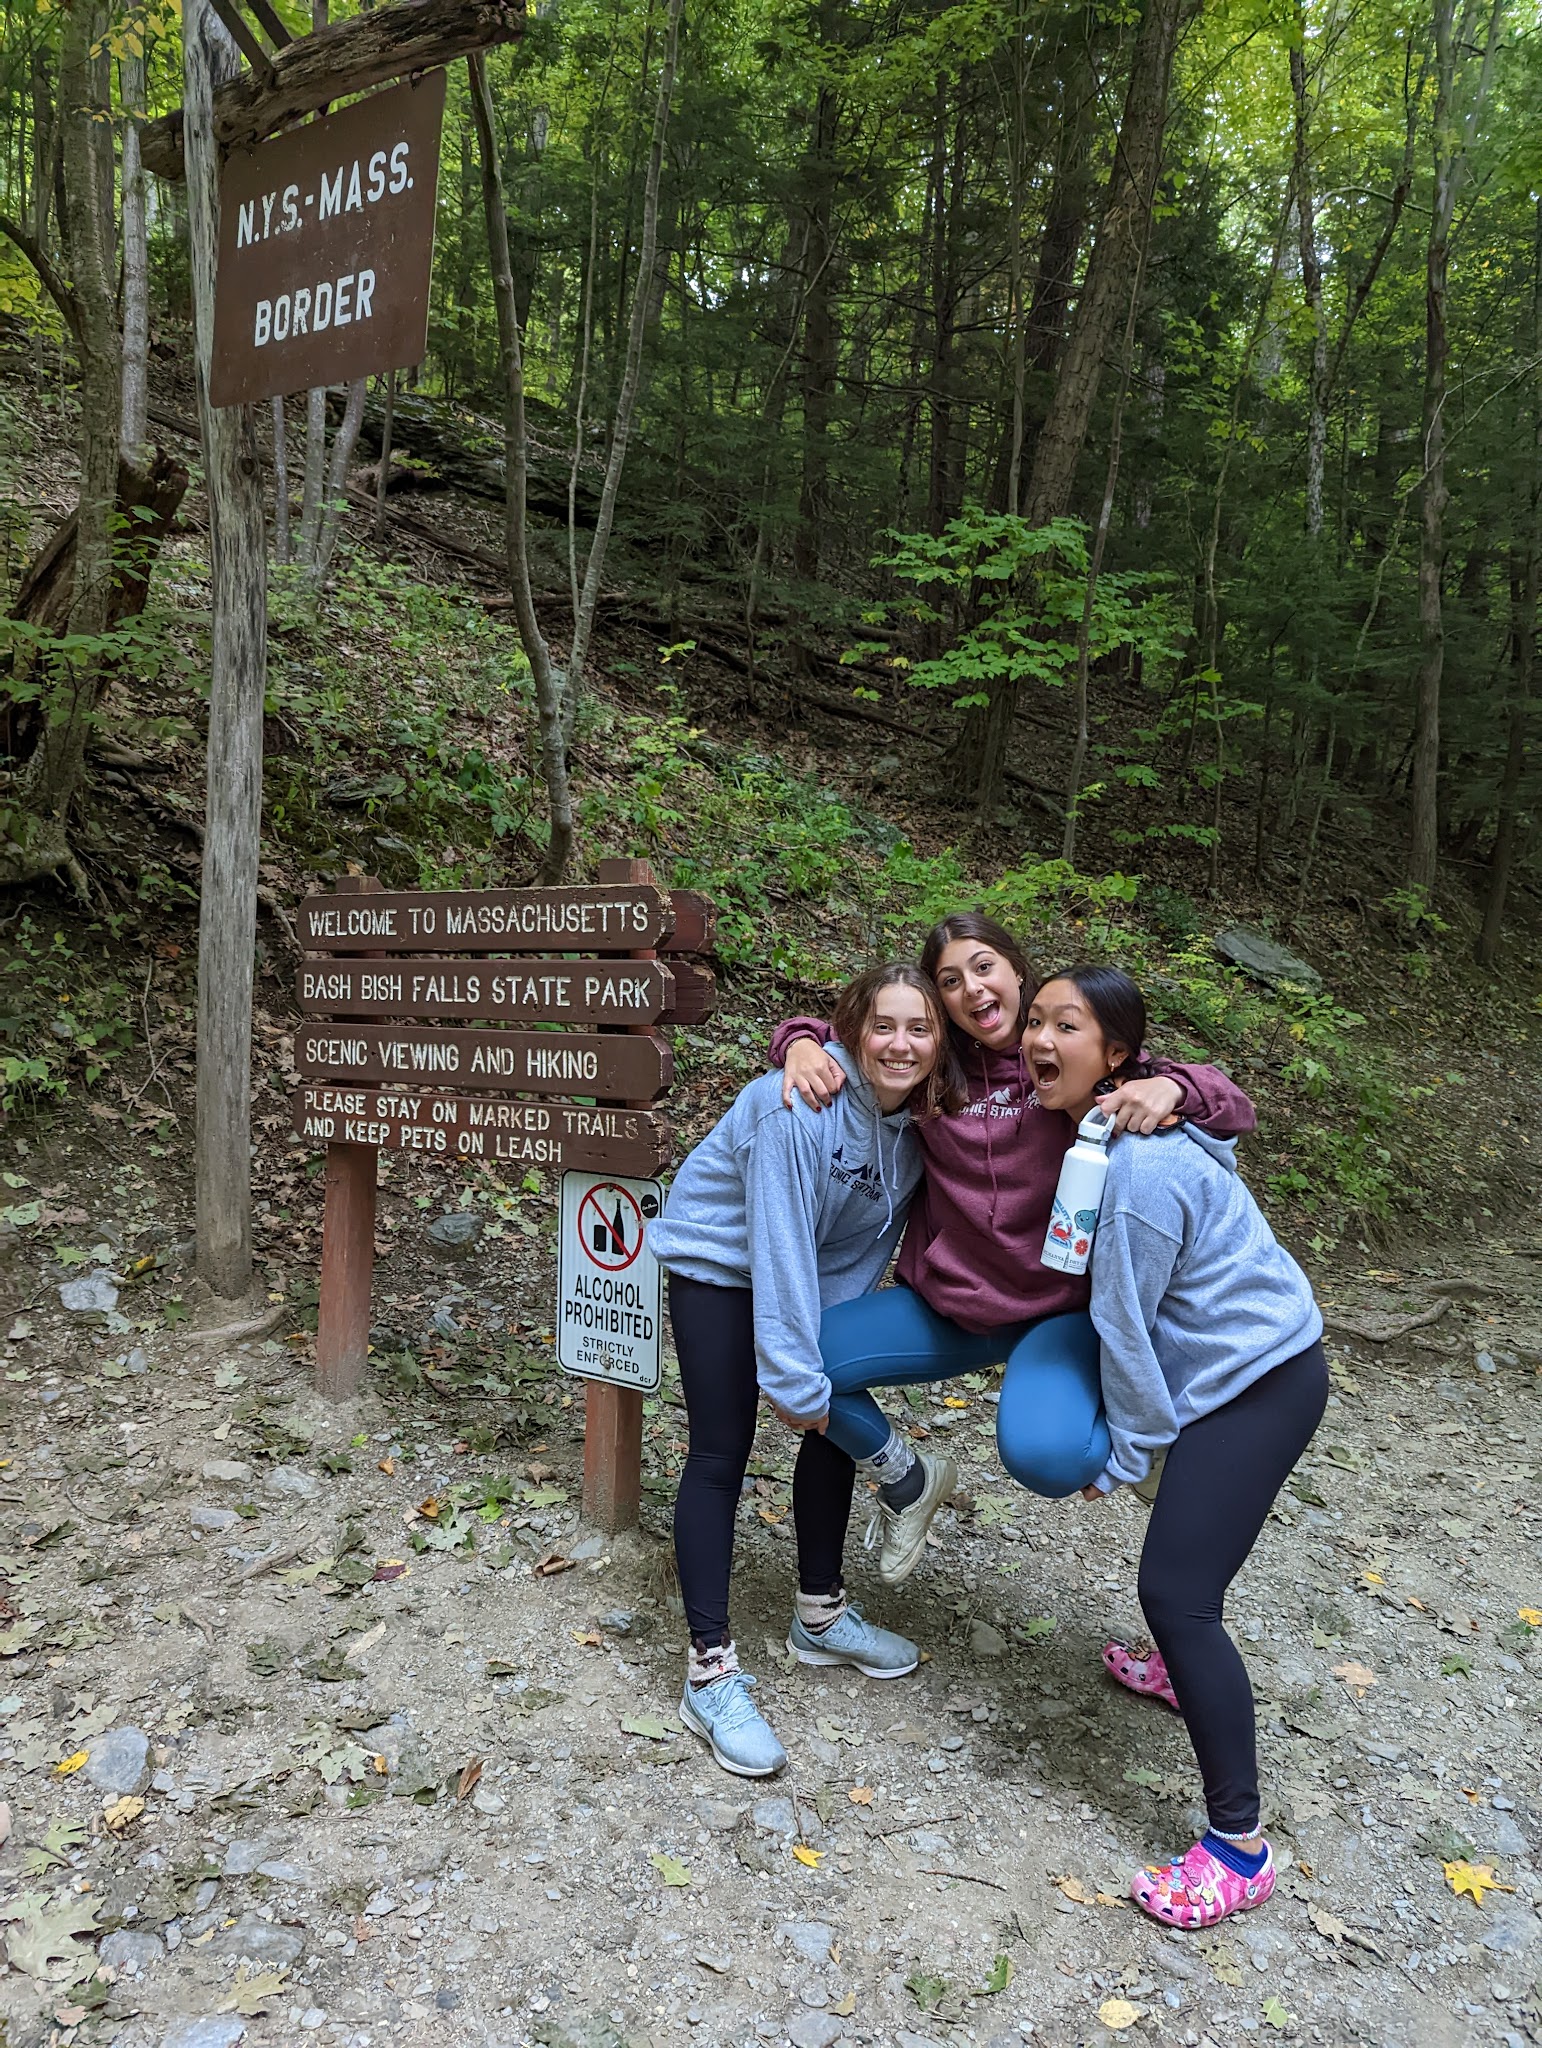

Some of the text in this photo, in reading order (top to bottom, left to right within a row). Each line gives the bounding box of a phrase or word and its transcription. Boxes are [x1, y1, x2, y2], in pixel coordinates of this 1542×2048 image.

[237, 142, 414, 248] N.Y.S.-MASS.
[254, 269, 376, 347] BORDER
[309, 901, 649, 937] WELCOME TO MASSACHUSETTS
[303, 974, 651, 1008] BASH BISH FALLS STATE PARK
[306, 1039, 598, 1080] SCENIC VIEWING AND HIKING
[303, 1090, 639, 1140] PLEASE STAY ON MARKED TRAILS
[990, 1104, 1022, 1118] STAT
[303, 1117, 562, 1163] AND KEEP PETS ON LEASH
[575, 1274, 644, 1309] ALCOHOL
[566, 1300, 653, 1340] PROHIBITED
[577, 1350, 639, 1374] ENFORCED
[583, 1336, 634, 1358] STRICTLY
[640, 1375, 651, 1383] dcr
